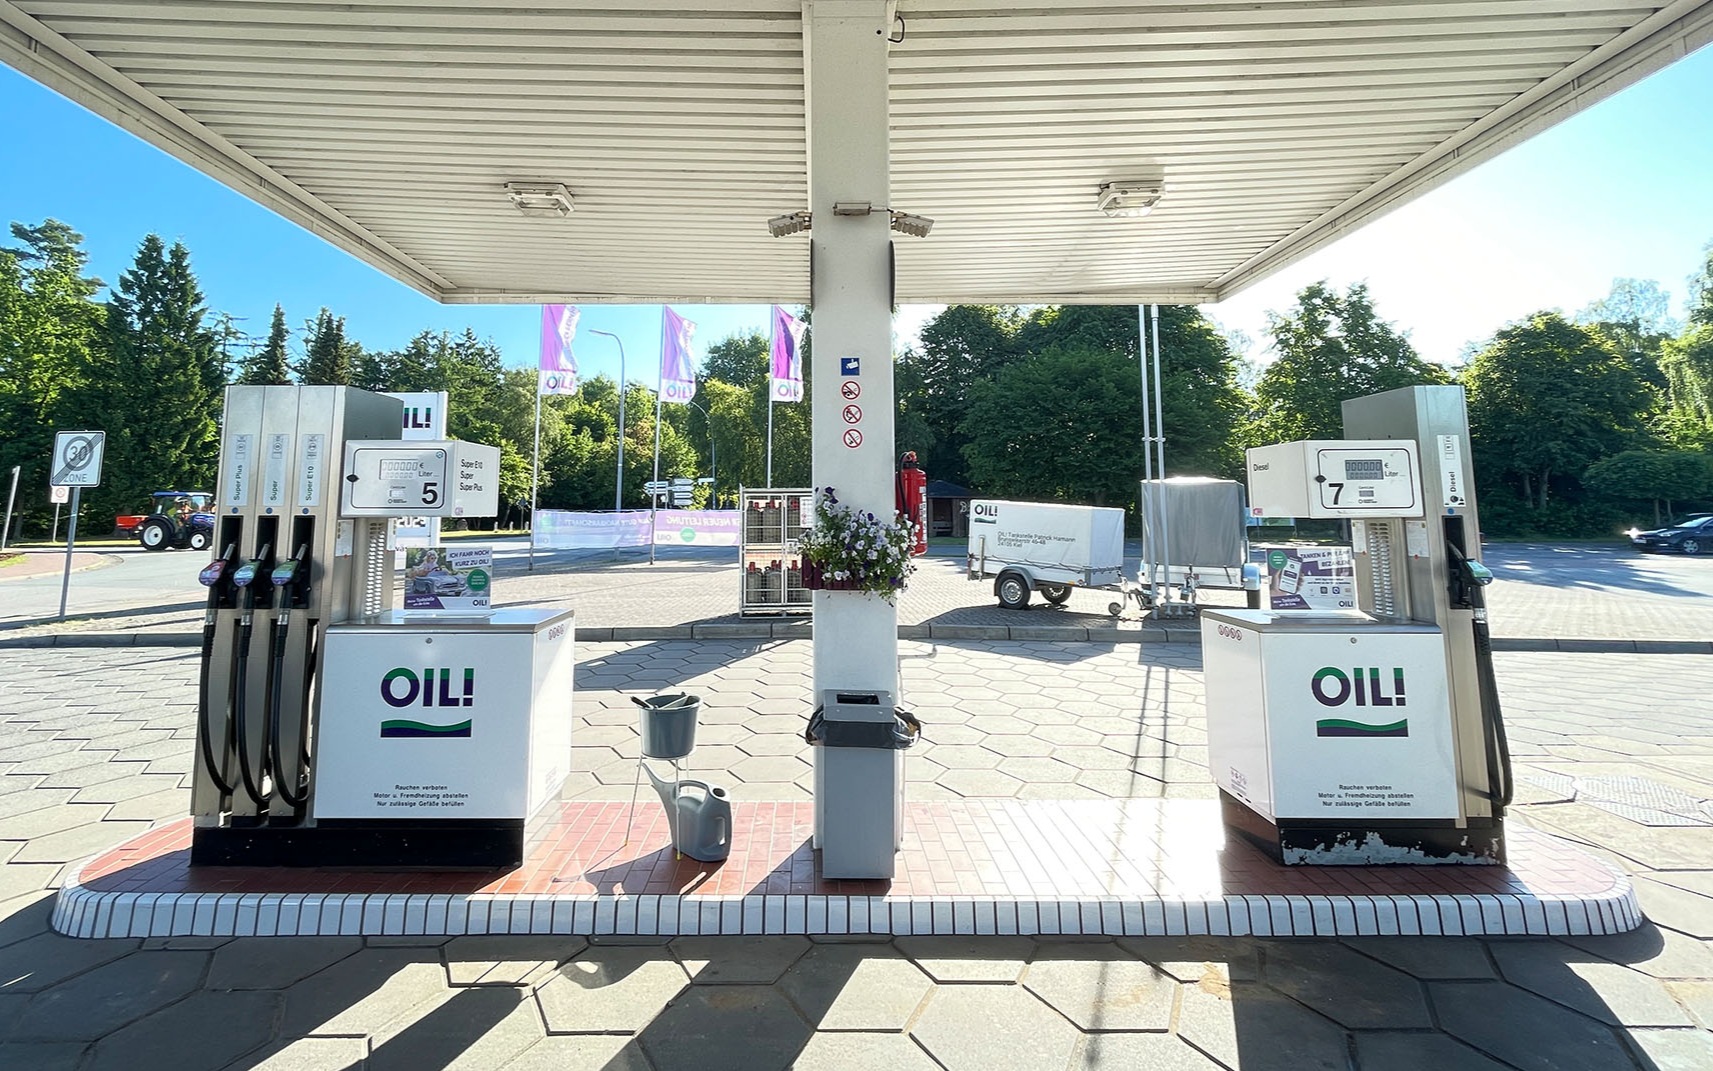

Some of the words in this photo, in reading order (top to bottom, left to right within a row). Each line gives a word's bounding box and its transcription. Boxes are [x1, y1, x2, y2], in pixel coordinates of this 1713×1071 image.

[546, 376, 574, 390] OIL!
[666, 384, 692, 399] OIL!
[402, 408, 432, 428] IL!
[68, 446, 88, 462] 30
[460, 458, 474, 468] Super
[474, 460, 482, 469] E10
[1254, 462, 1270, 472] Diesel
[64, 474, 88, 482] ZONE
[235, 464, 243, 480] Plus
[306, 466, 315, 479] E10
[460, 470, 474, 480] Super
[233, 480, 242, 500] Super
[270, 480, 278, 500] Super
[305, 480, 314, 500] Super
[460, 482, 474, 491] Super
[474, 483, 482, 491] Plus
[1448, 472, 1456, 492] Diesel
[422, 482, 438, 504] 5
[1328, 482, 1344, 506] 7
[974, 504, 998, 517] OIL!
[380, 667, 474, 707] OIL!
[1311, 666, 1406, 707] OIL!
